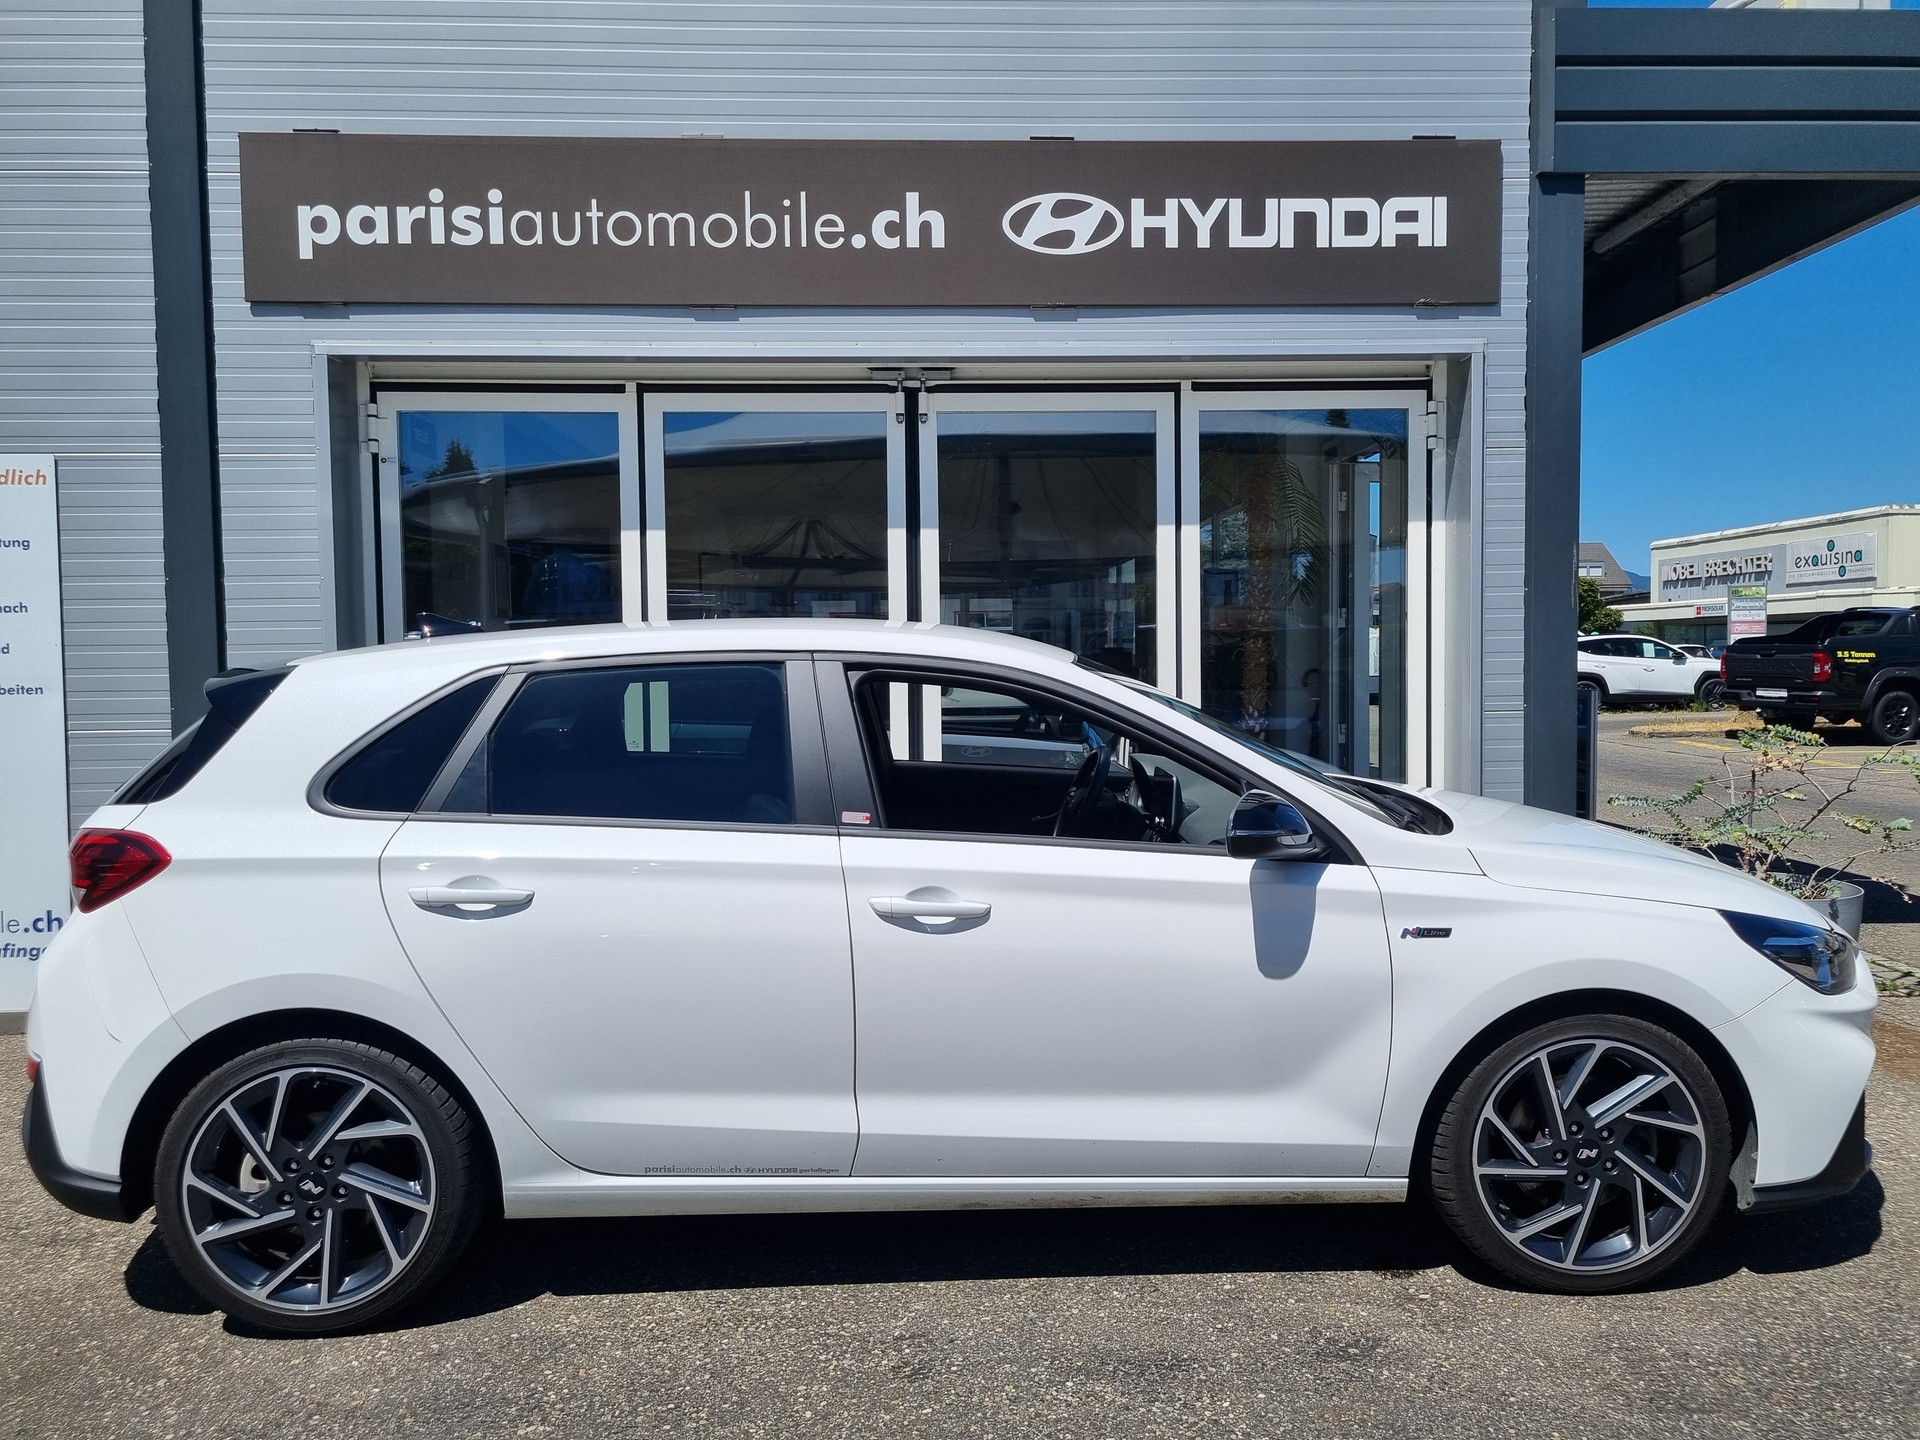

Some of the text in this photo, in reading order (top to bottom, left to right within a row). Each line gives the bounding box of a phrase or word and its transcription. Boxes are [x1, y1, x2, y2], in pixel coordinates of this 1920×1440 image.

[297, 187, 946, 260] parisiautomobile.ch
[1131, 195, 1448, 249] HYUNDAI
[0, 942, 47, 961] fing
[644, 1165, 741, 1174] parisiautomobile.ch
